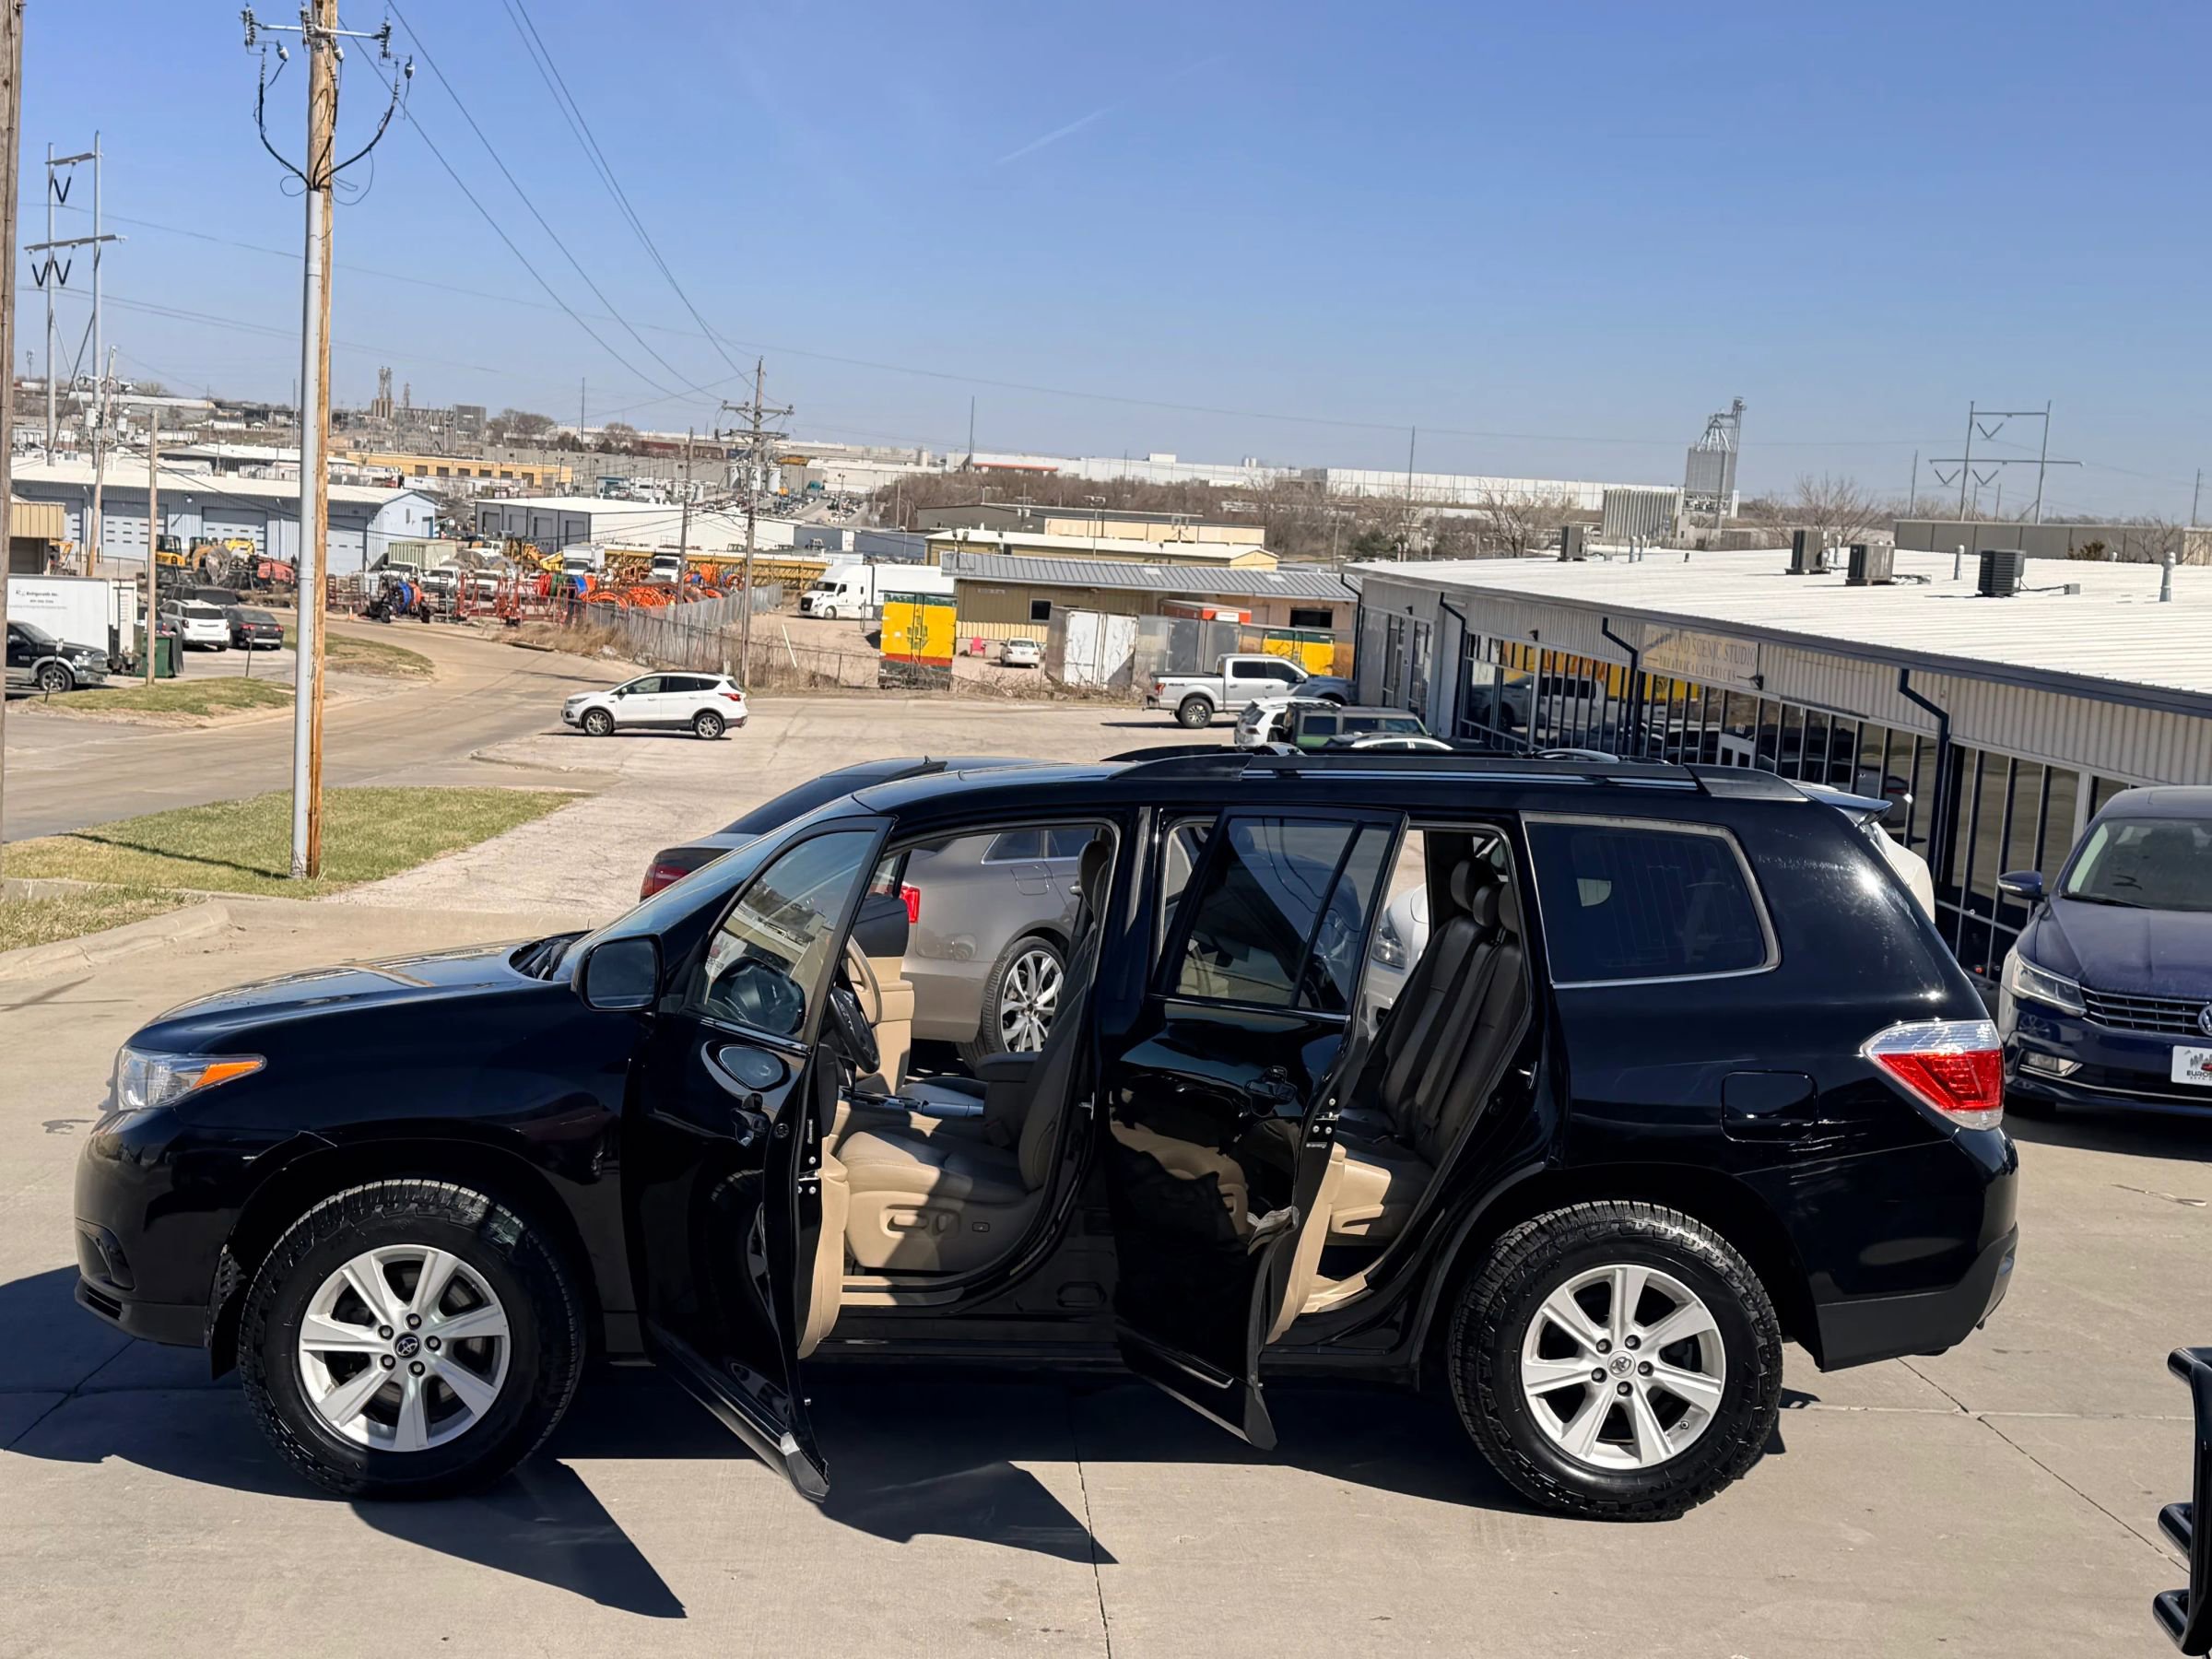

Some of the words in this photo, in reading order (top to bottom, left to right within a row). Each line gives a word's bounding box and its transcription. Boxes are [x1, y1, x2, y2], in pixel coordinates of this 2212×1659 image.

[1693, 638, 1722, 661] SCENIC
[1724, 643, 1757, 667] STUDIO
[1702, 665, 1736, 681] SERVICES
